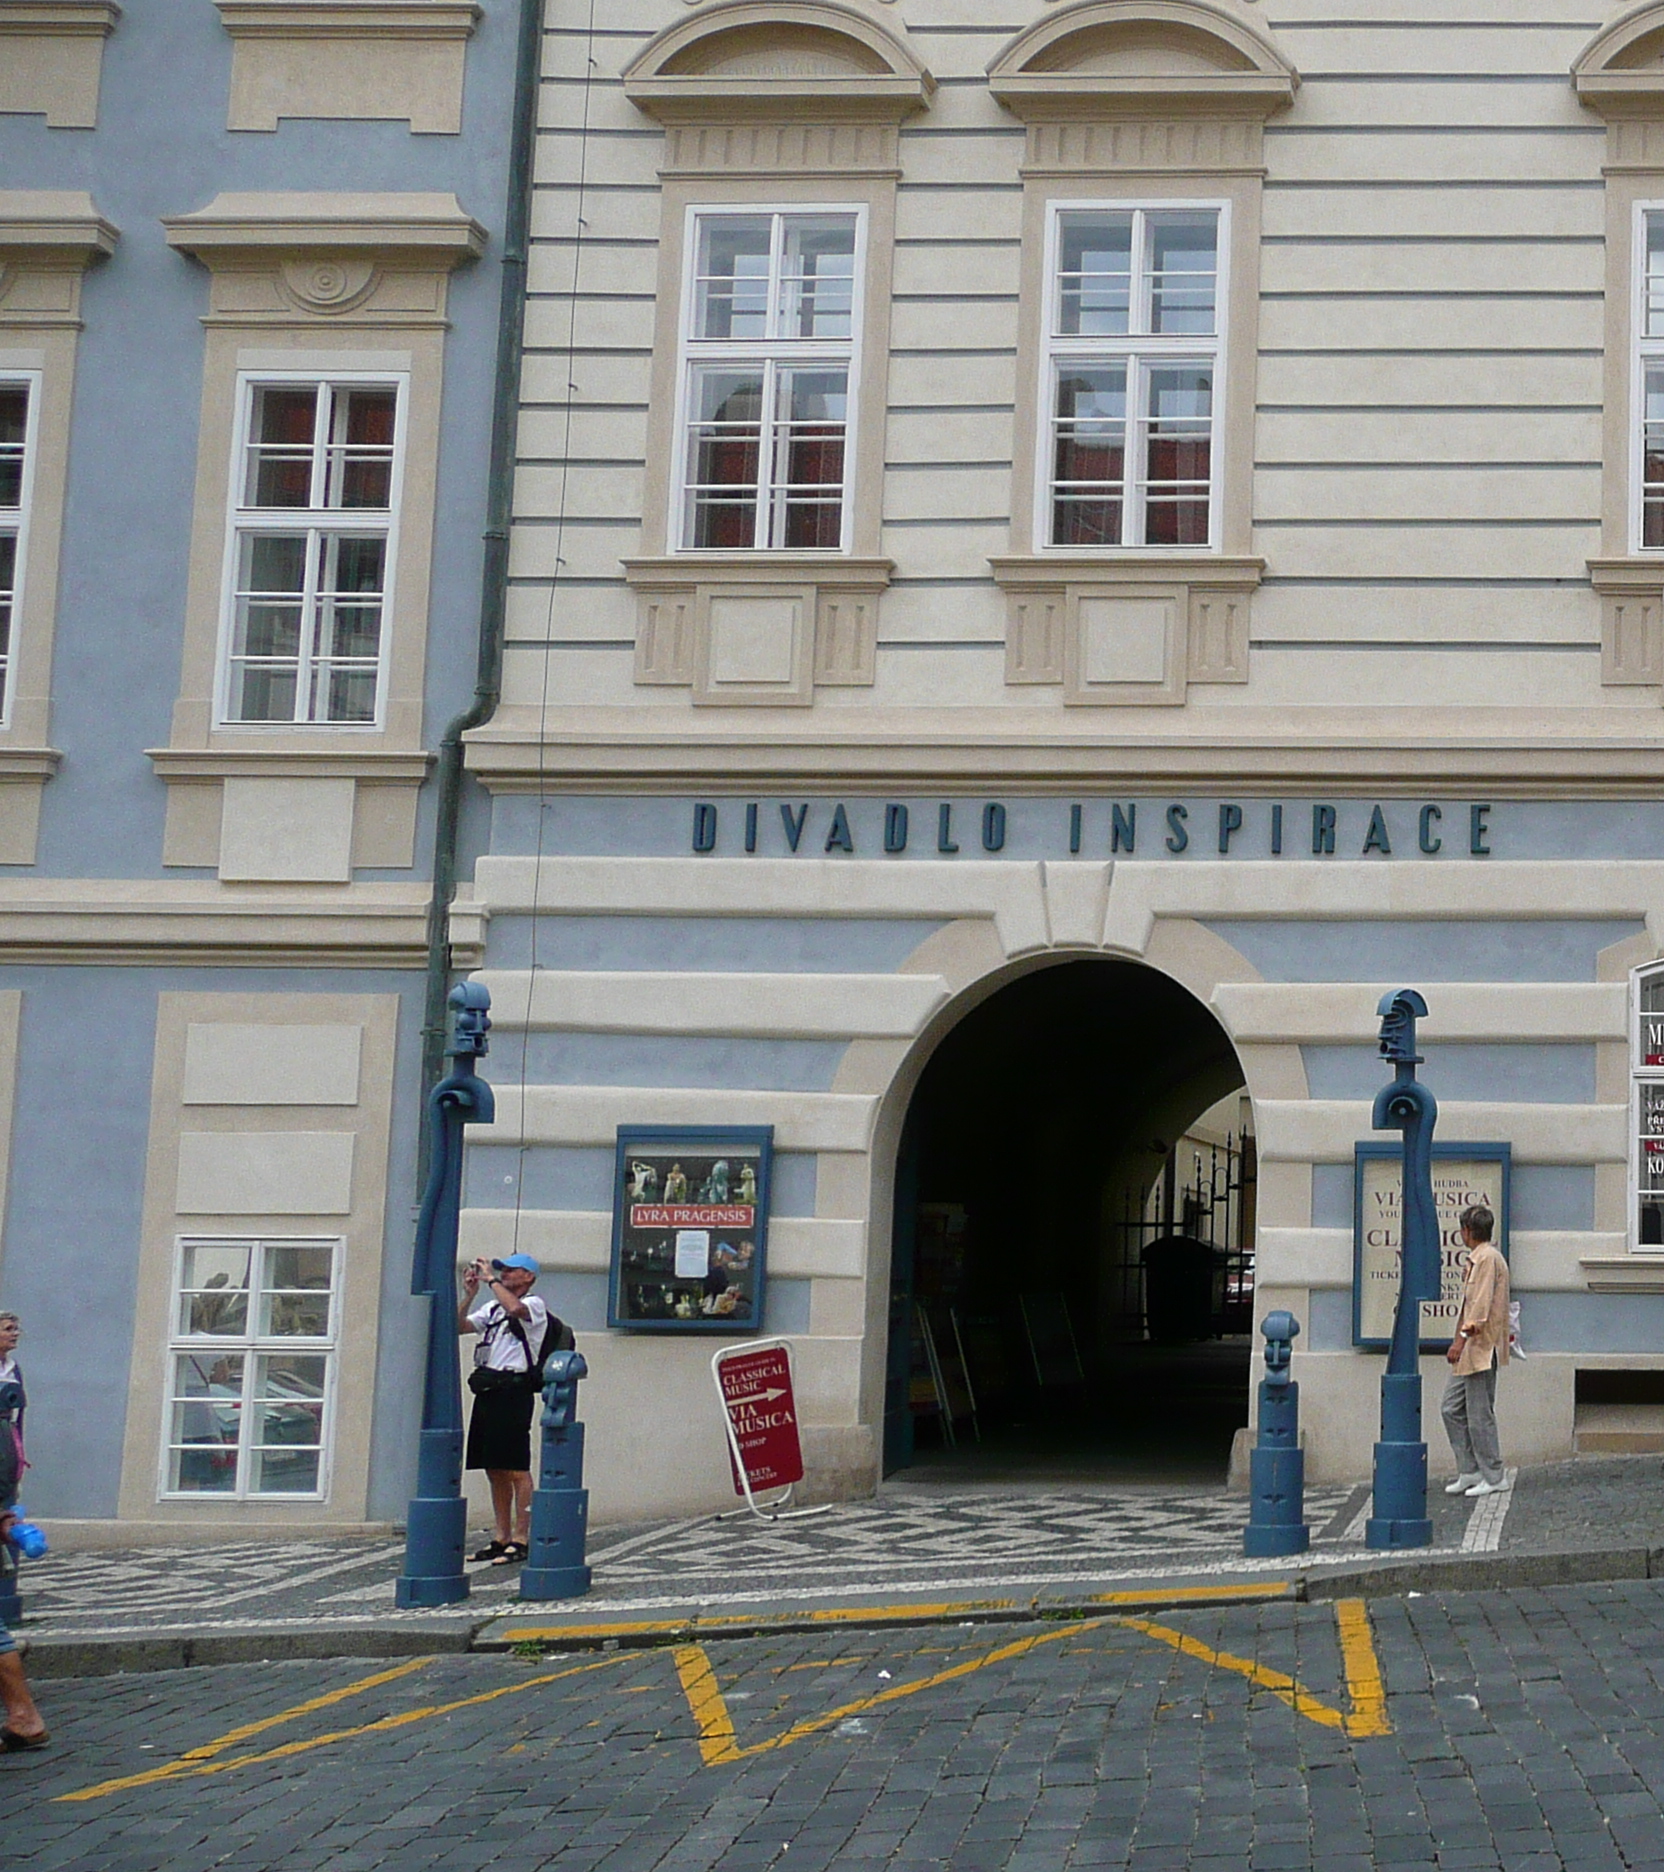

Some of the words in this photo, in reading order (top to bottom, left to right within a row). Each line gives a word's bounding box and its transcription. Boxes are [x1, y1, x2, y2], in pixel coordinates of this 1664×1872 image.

[691, 801, 1007, 854] DIVADLO
[1069, 803, 1492, 856] INSPIRACE
[1434, 1180, 1469, 1188] HUDBA
[1434, 1191, 1491, 1206] USICA
[637, 1209, 670, 1222] LYRA
[674, 1209, 747, 1222] PRAGENSIS
[1422, 1304, 1459, 1318] SHO
[723, 1364, 786, 1386] CLASSICAL
[725, 1380, 762, 1397] MUSIC
[728, 1404, 757, 1421] VIA
[731, 1410, 794, 1435] MUSICA
